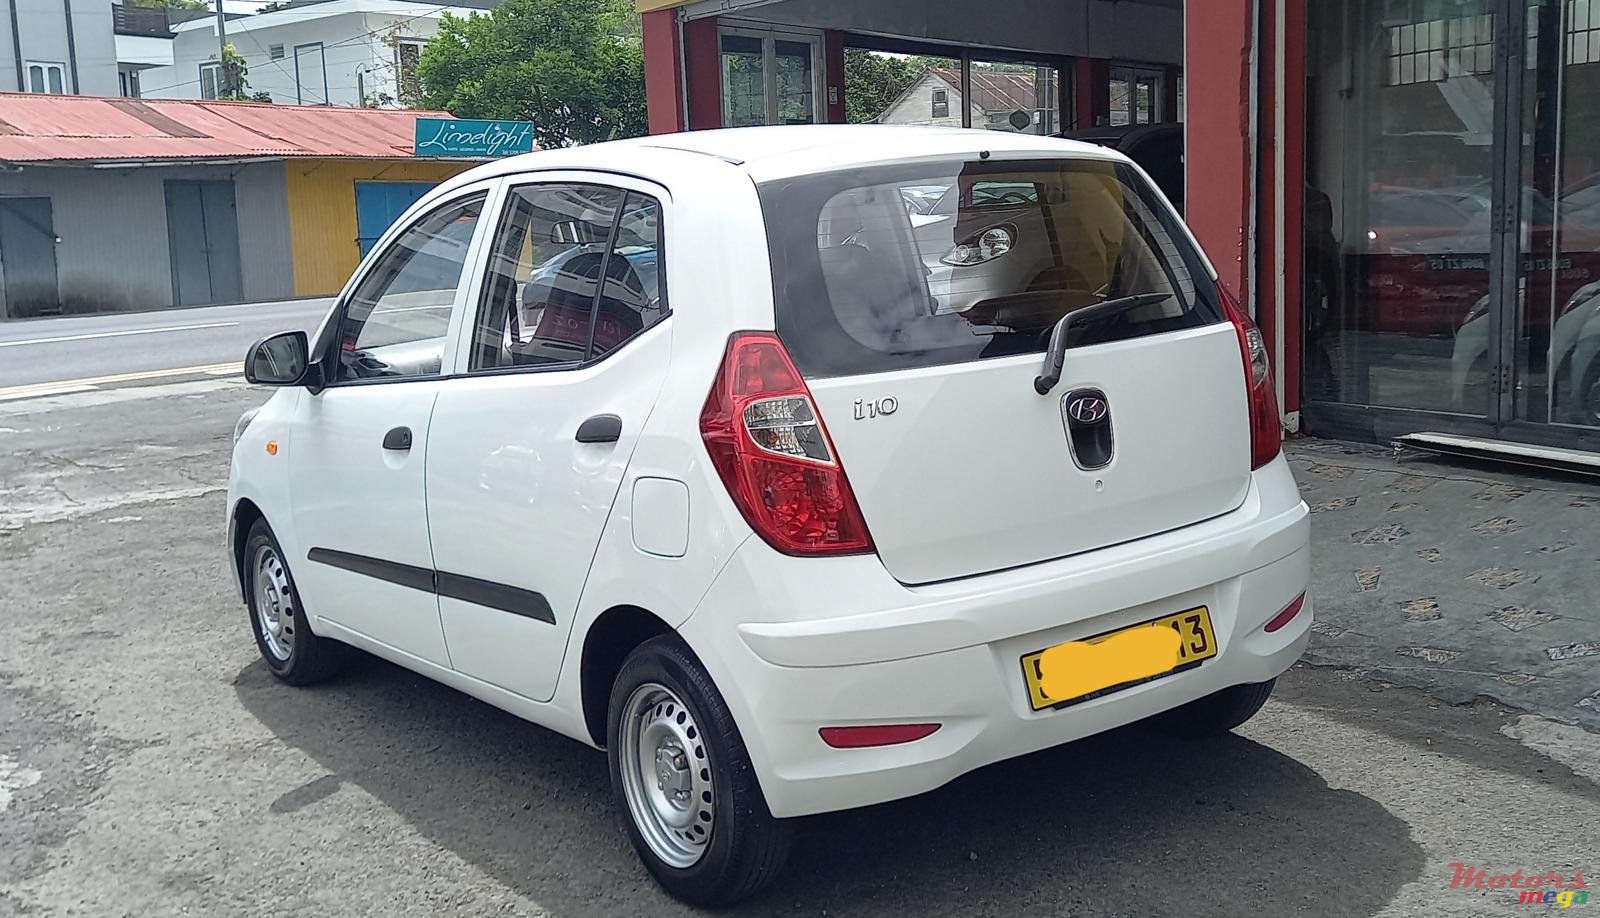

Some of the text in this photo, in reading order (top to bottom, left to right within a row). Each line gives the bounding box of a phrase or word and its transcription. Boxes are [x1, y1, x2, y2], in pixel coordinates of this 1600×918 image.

[418, 121, 531, 155] Limelight
[853, 395, 899, 420] i10
[1171, 614, 1208, 658] 13
